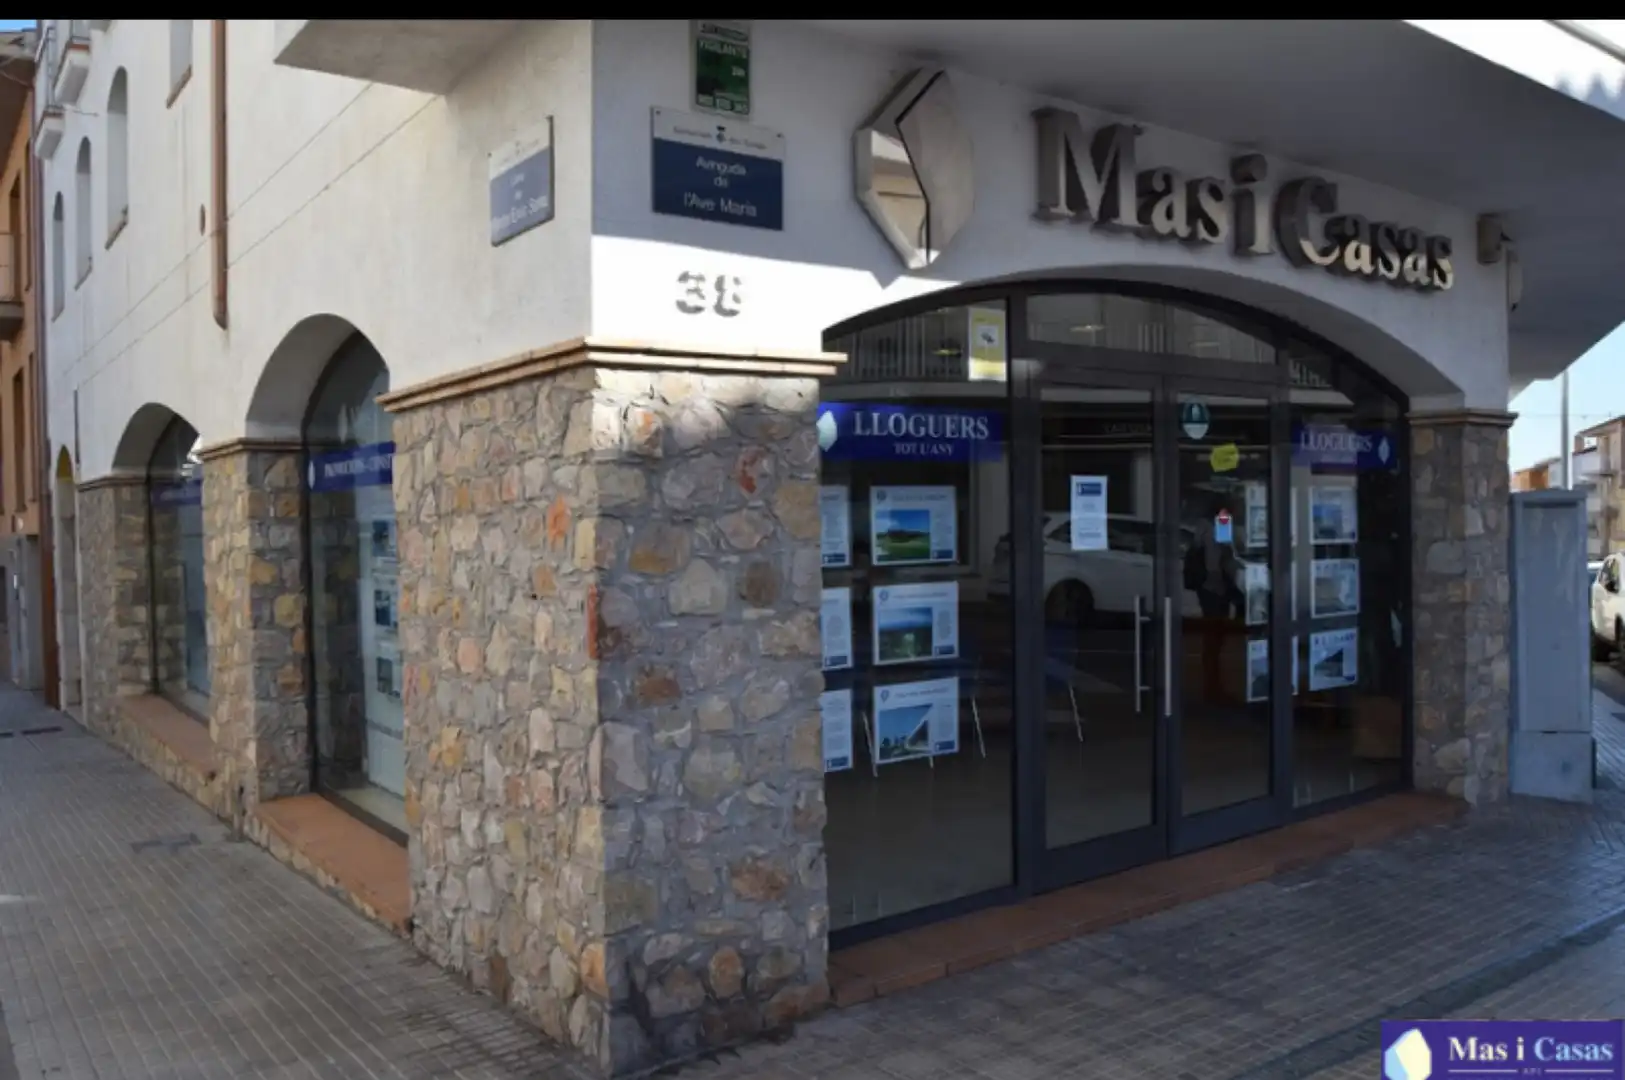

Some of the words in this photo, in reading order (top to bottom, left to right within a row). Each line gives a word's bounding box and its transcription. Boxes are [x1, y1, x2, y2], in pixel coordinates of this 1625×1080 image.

[1033, 105, 1232, 245] Mas
[1275, 176, 1454, 291] Casas
[854, 411, 990, 440] LLOGUERS
